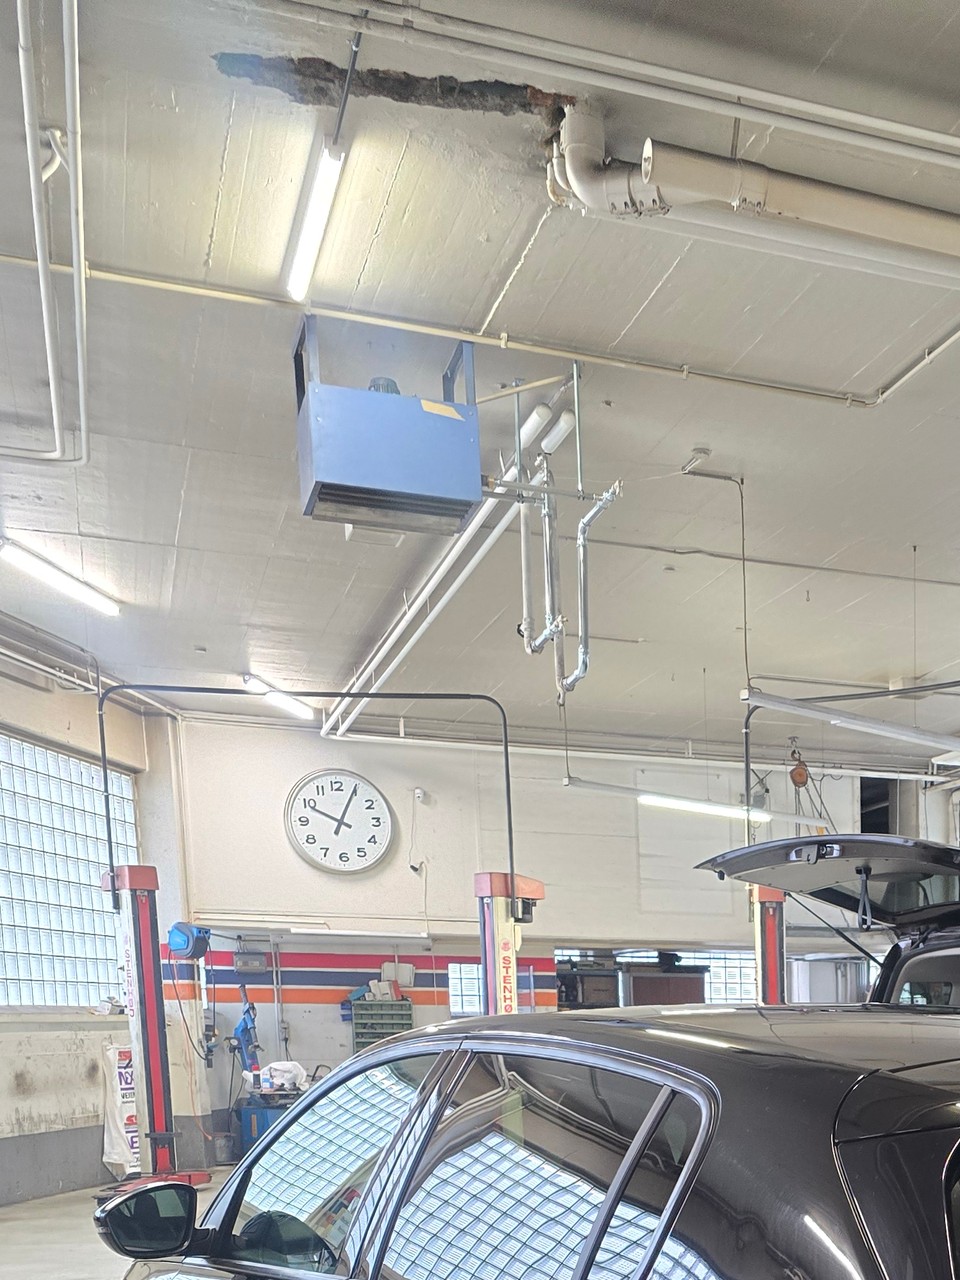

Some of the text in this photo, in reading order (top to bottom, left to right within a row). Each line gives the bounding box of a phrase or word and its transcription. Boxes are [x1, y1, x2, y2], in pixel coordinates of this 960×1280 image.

[316, 785, 325, 796] 11
[330, 781, 344, 792] 12
[303, 798, 317, 809] 10
[365, 799, 375, 810] 2
[298, 816, 310, 827] 9
[371, 817, 382, 828] 3
[305, 834, 317, 845] 8
[367, 835, 378, 846] 4
[319, 847, 330, 858] 7
[338, 852, 350, 863] 6
[356, 847, 367, 858] 5
[502, 956, 513, 1013] STENHØ
